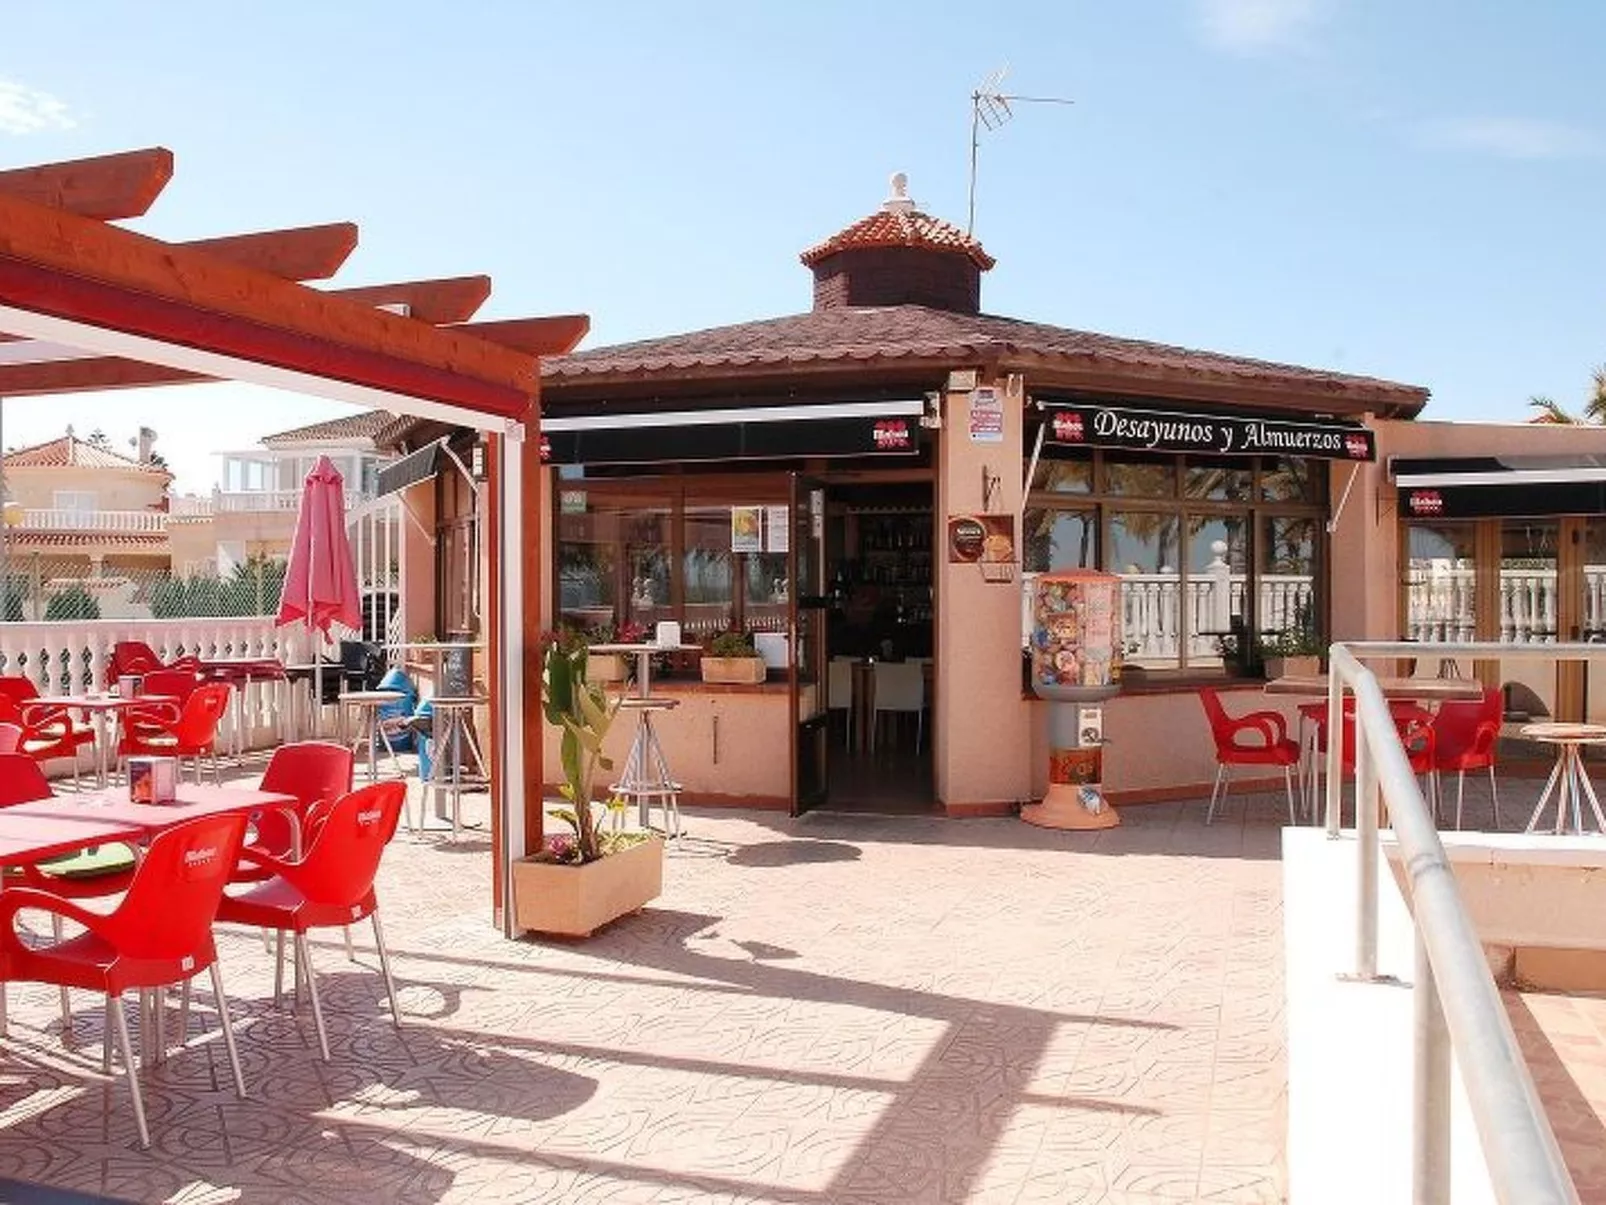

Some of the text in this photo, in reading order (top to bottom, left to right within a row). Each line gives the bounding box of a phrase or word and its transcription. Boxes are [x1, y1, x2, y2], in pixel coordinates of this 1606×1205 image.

[1093, 410, 1341, 452] Desayunos y Almuerzos
